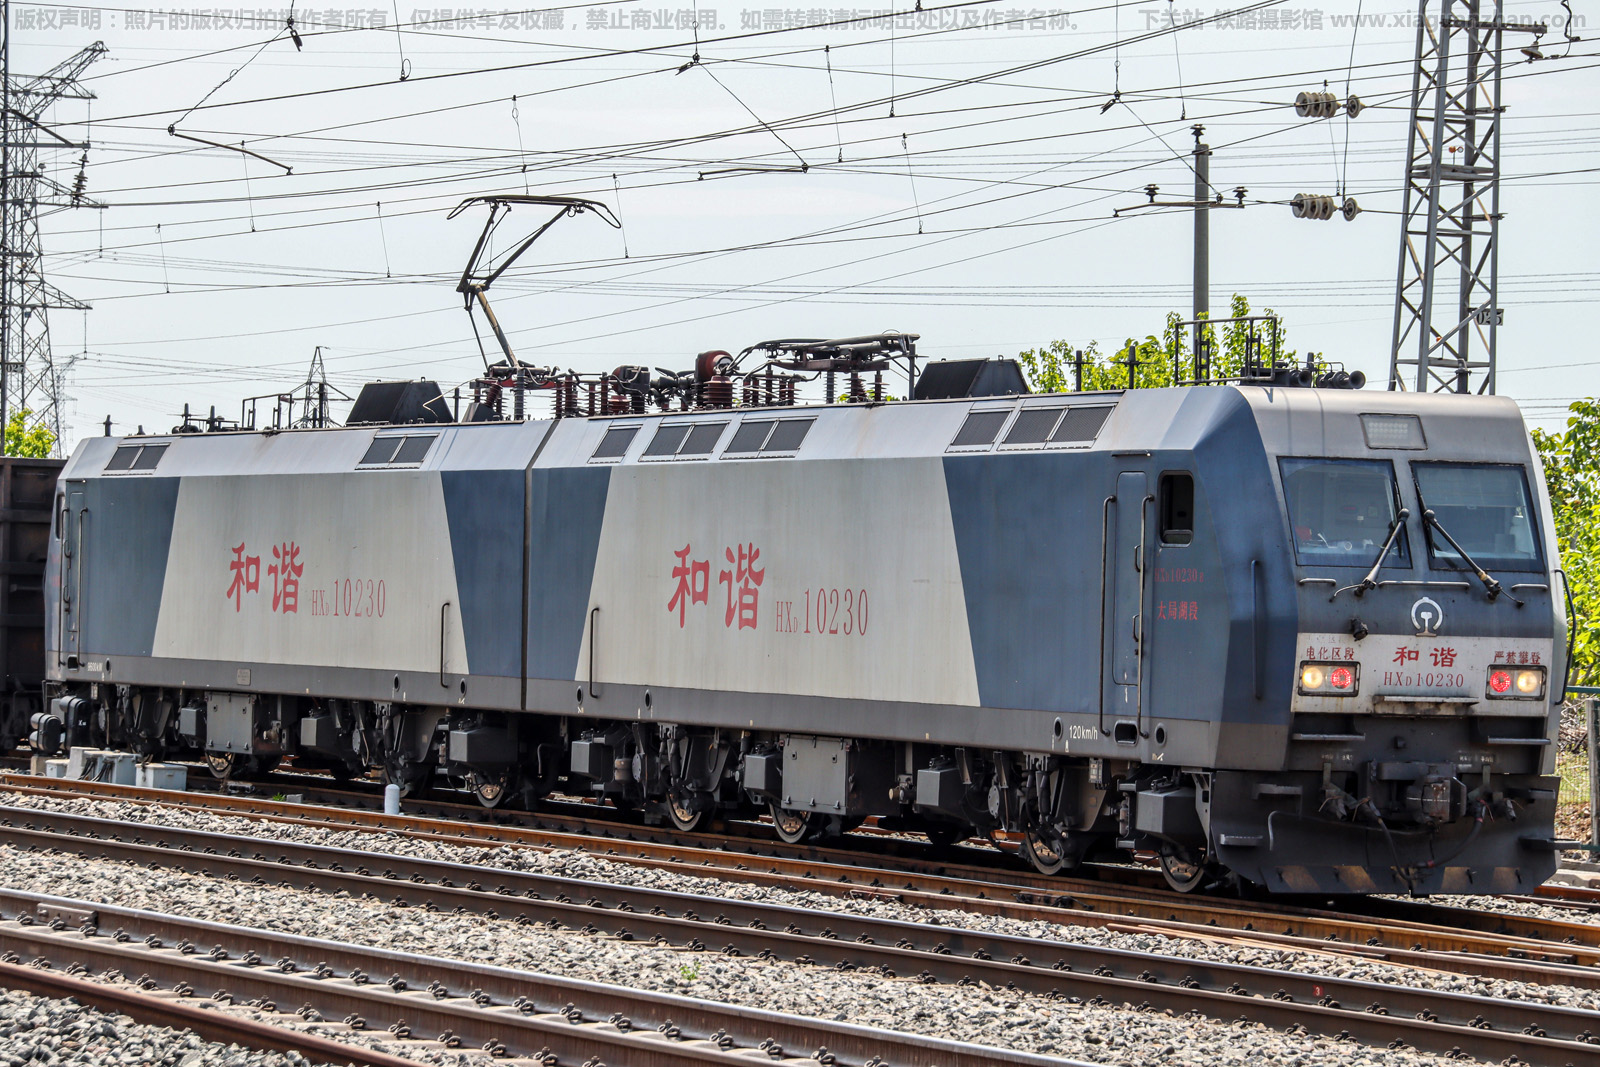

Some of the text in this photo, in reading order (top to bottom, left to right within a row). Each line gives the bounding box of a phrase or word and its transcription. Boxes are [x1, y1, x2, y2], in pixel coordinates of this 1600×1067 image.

[226, 541, 305, 614] 和谐
[667, 542, 766, 631] 和谐
[1306, 645, 1355, 661] 电化区段
[1392, 646, 1458, 667] 和谐
[1493, 650, 1541, 665] 严禁攀登
[1383, 671, 1464, 688] HXD10230
[1315, 986, 1321, 996] 3
